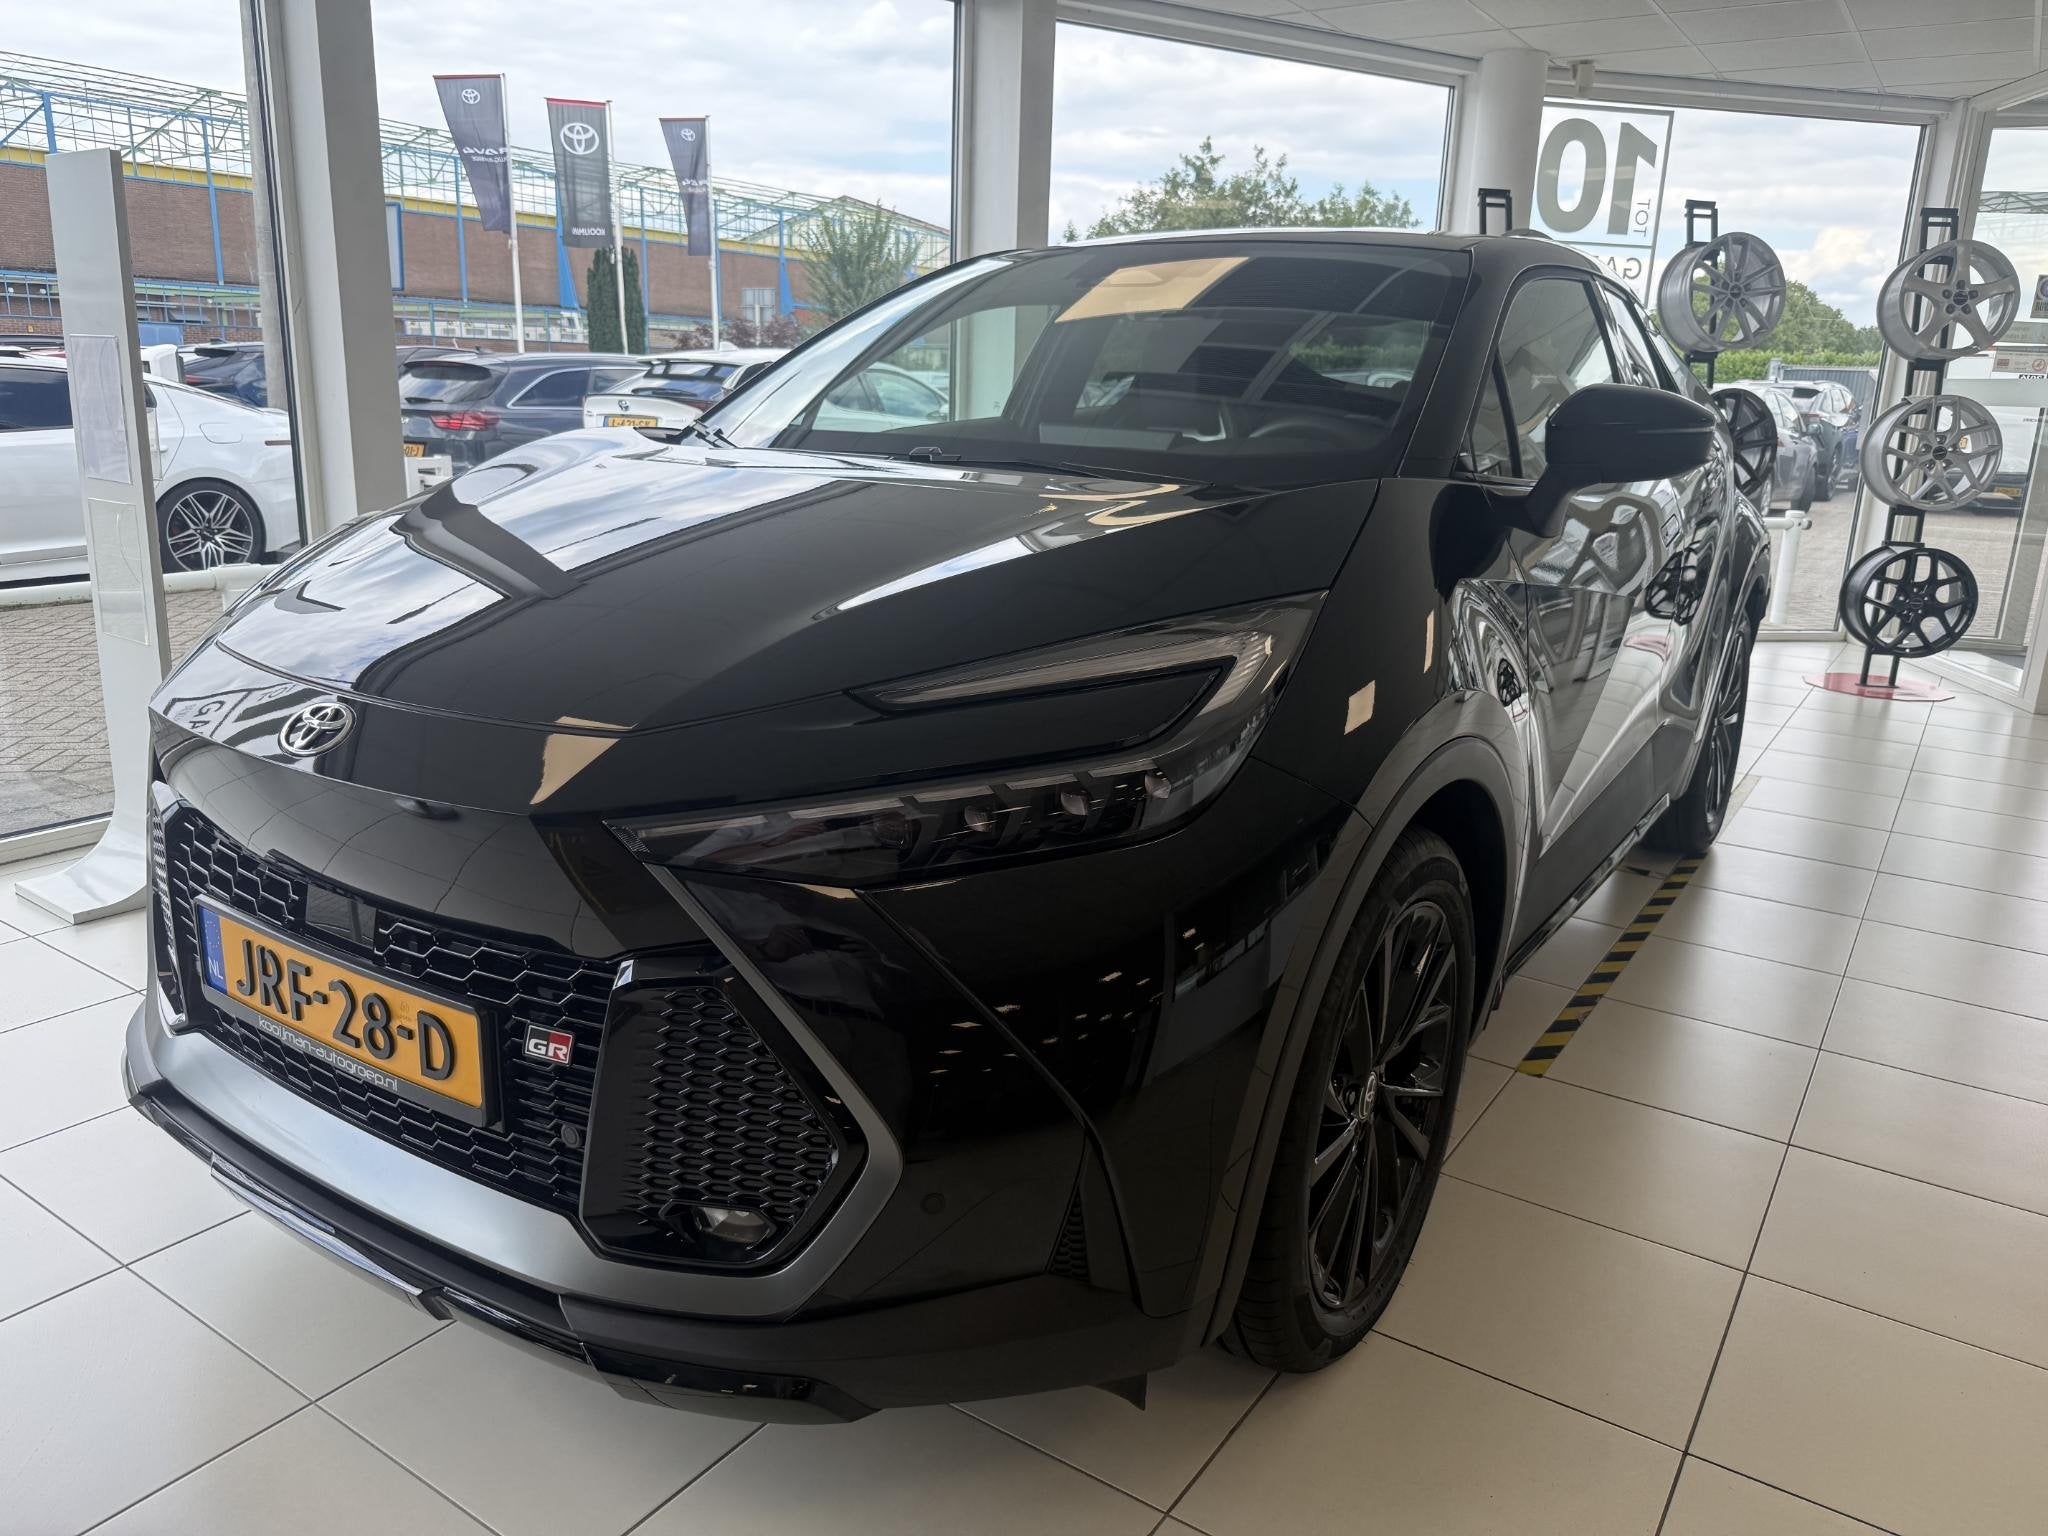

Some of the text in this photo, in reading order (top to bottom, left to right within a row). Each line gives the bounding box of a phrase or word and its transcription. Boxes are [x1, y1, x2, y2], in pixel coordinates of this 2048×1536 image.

[207, 958, 224, 980] NL
[236, 938, 455, 1081] JRF-28-D
[258, 1015, 398, 1092] kooijman-autogroep.nl
[528, 1038, 568, 1060] GR
